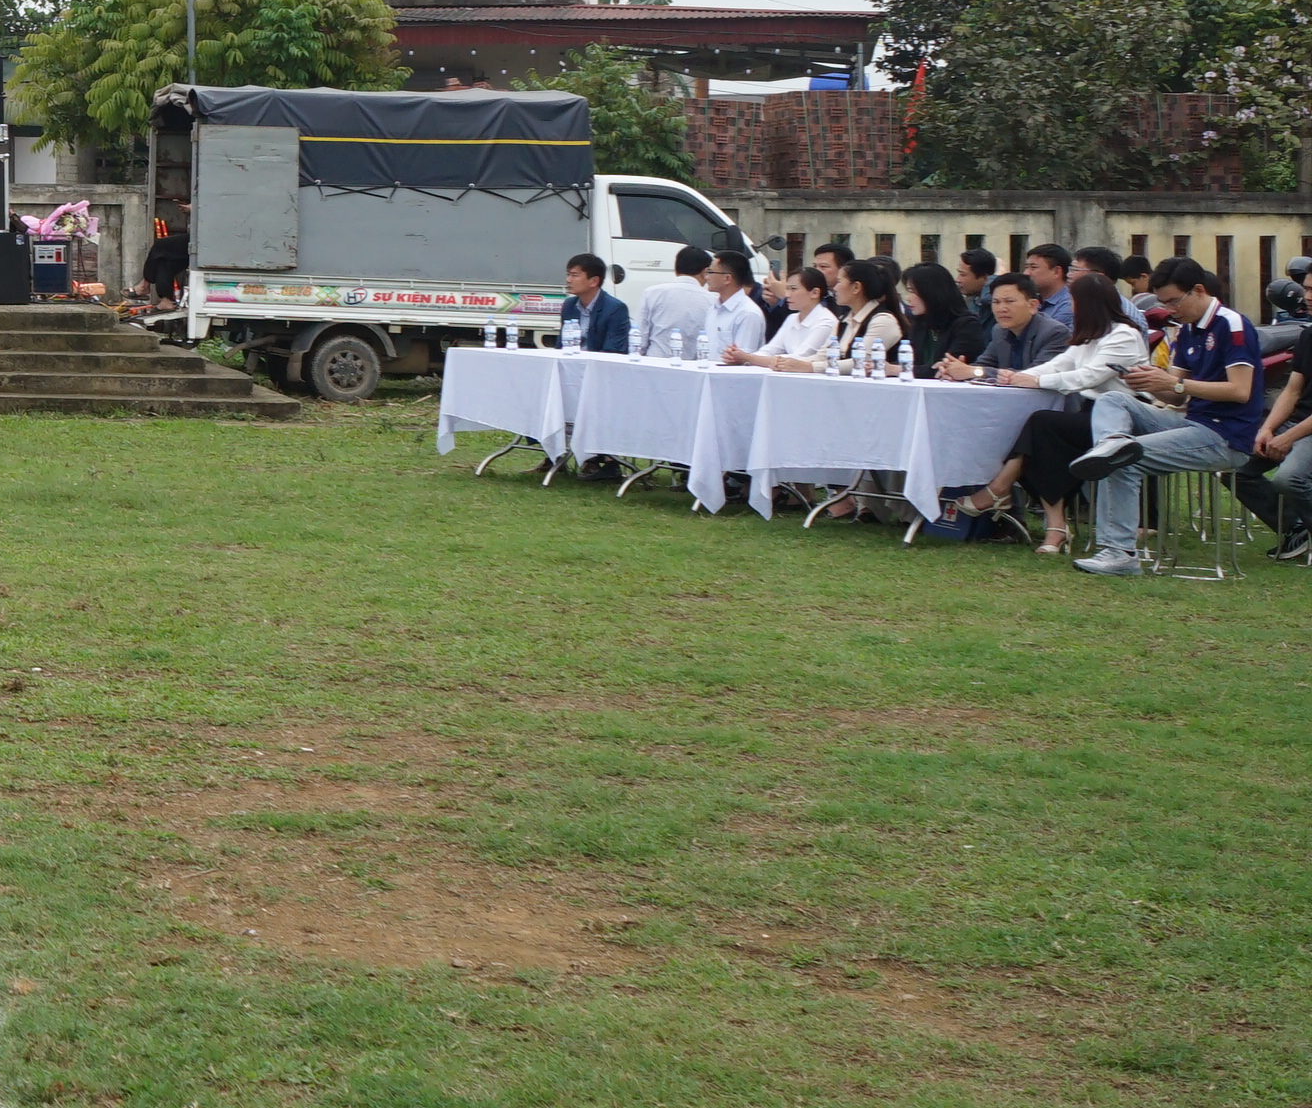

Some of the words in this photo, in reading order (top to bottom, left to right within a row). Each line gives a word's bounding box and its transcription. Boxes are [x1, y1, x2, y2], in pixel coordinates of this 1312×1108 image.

[347, 292, 365, 302] HT
[372, 291, 394, 305] SỰ
[396, 291, 432, 306] KIỆN
[435, 293, 456, 304] HÀ
[461, 292, 497, 306] TĨNH
